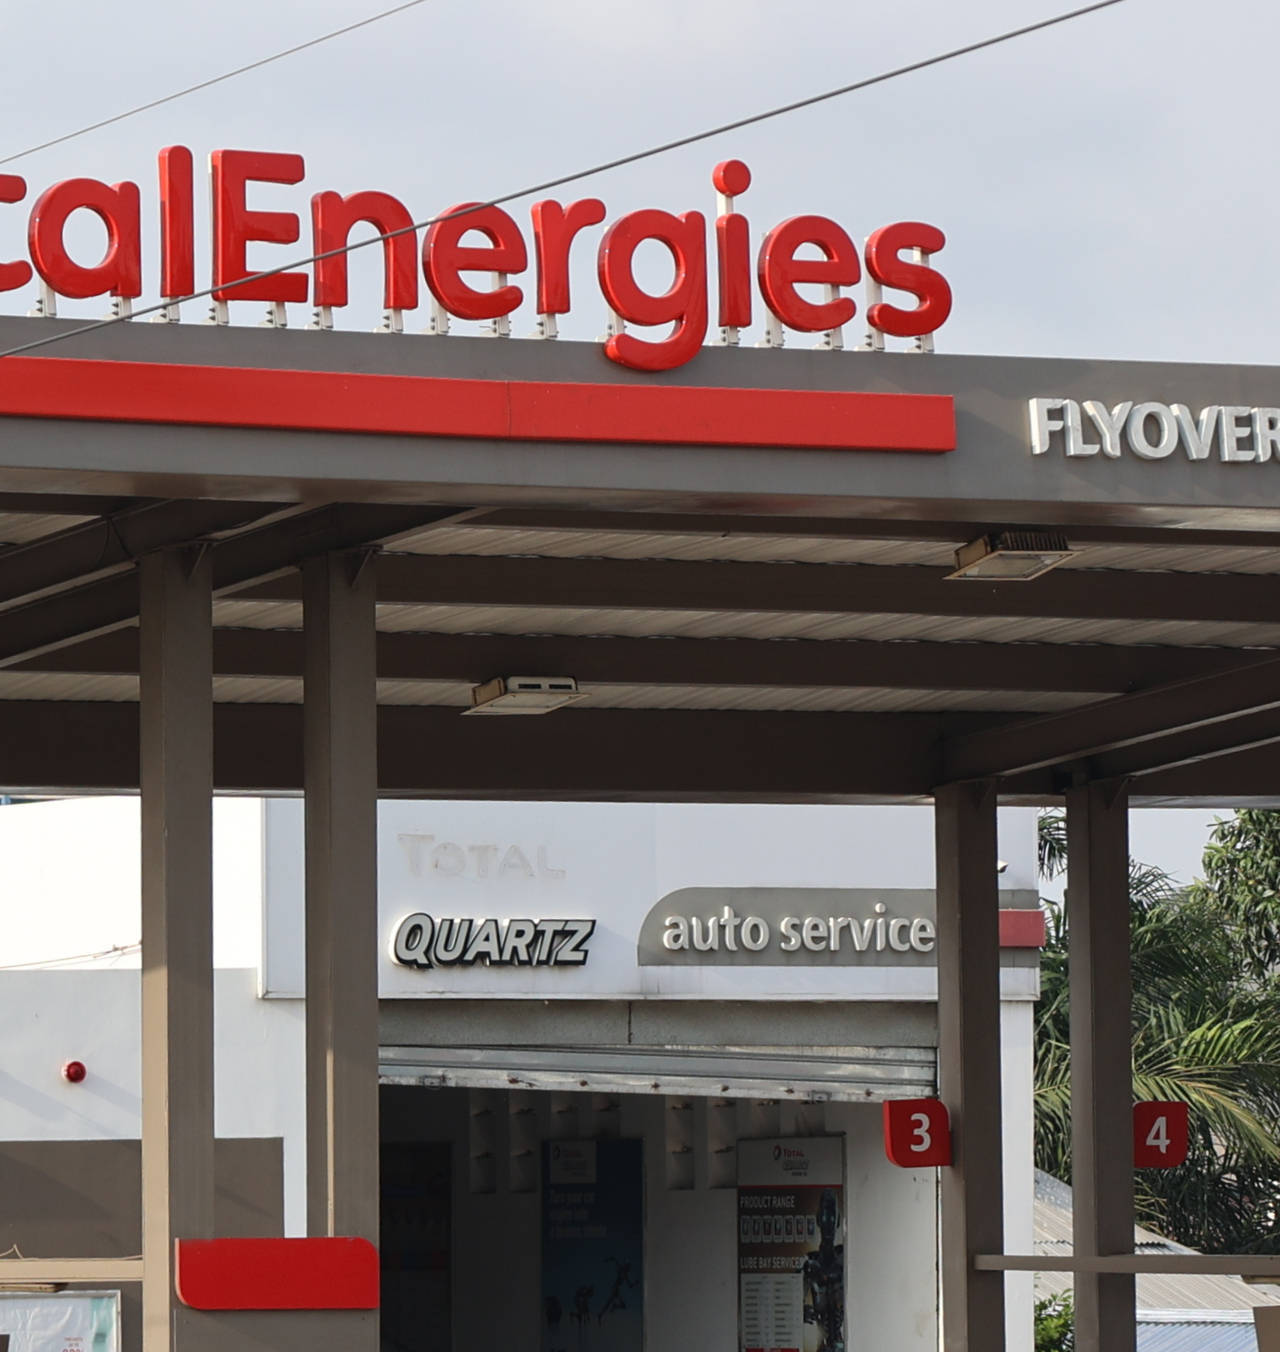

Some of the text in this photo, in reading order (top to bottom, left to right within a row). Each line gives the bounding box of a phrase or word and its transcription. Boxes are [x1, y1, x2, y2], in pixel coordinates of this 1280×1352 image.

[1028, 397, 1280, 463] FLYOVER
[391, 911, 595, 969] QUARTZ
[664, 902, 935, 952] auto service
[910, 1113, 931, 1152] 3
[1146, 1116, 1171, 1154] 4
[740, 1196, 795, 1208] PRODUCT RANGE
